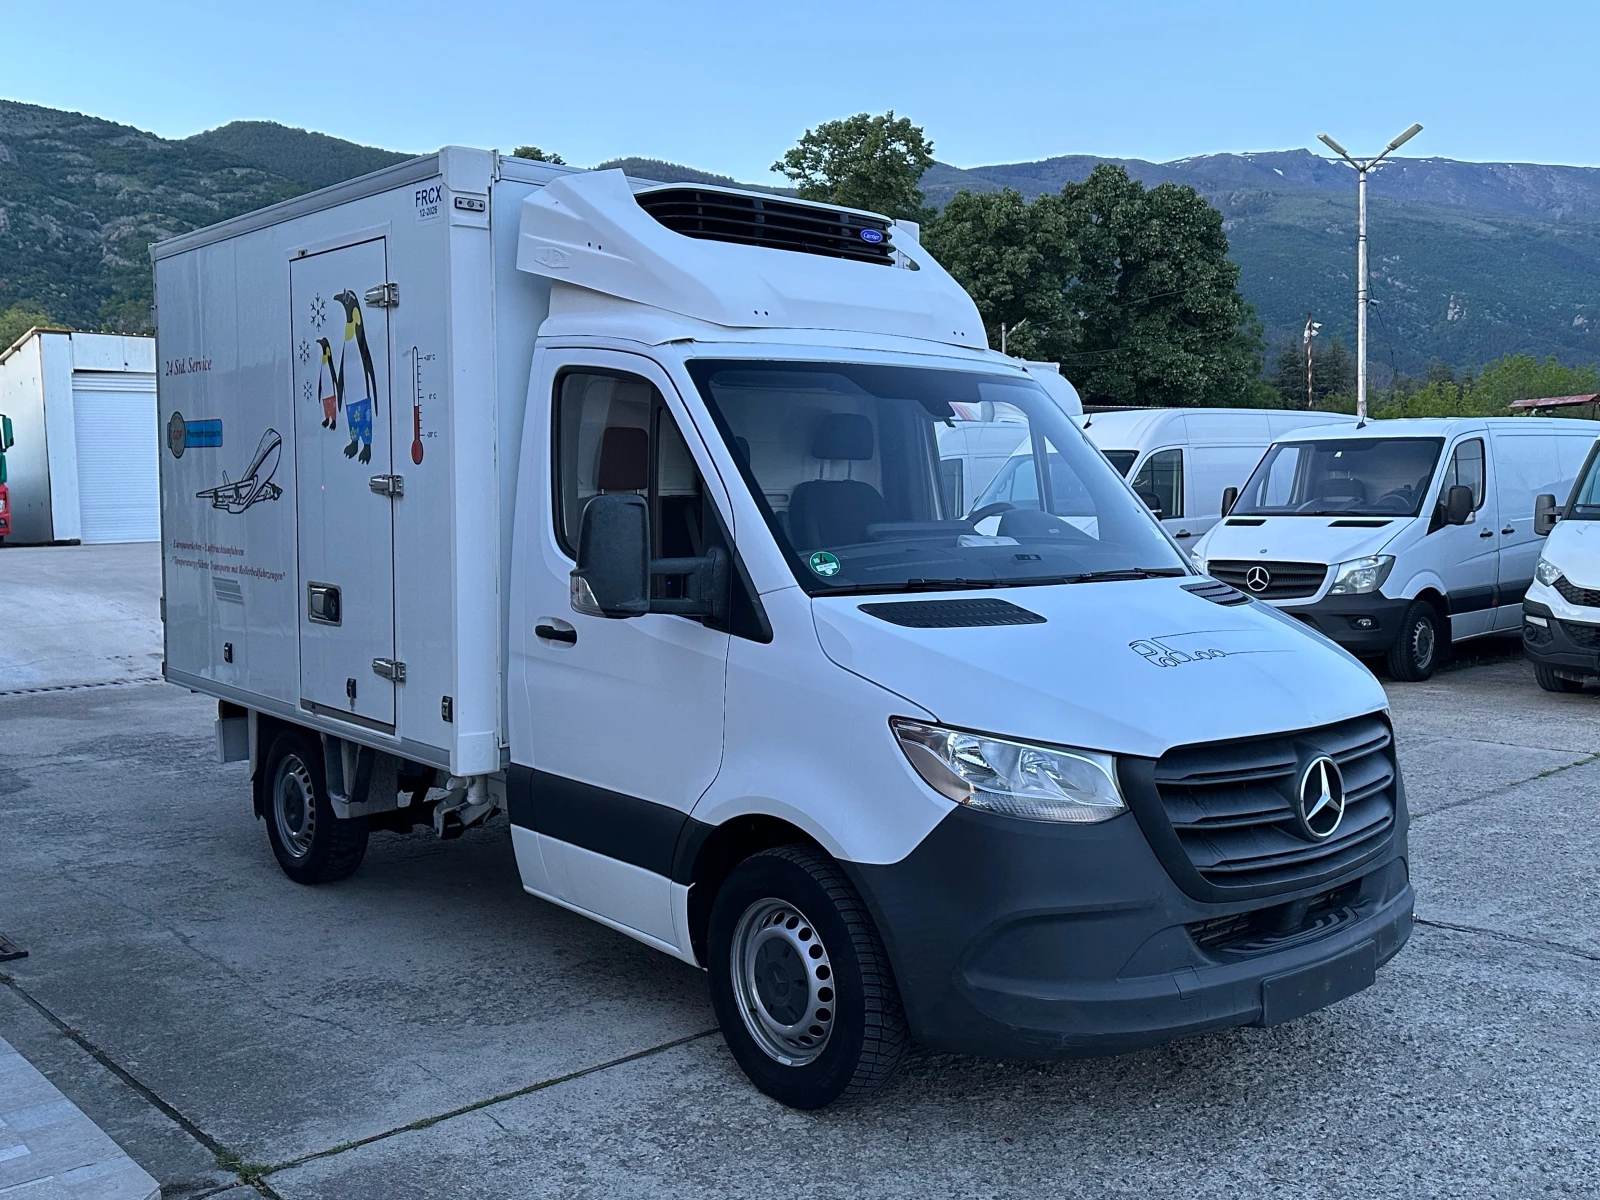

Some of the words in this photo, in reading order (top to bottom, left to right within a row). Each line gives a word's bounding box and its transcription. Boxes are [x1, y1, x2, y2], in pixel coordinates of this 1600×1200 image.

[415, 185, 442, 208] FRCX
[863, 232, 880, 240] Carrier
[165, 360, 173, 376] 24
[187, 355, 212, 374] Service
